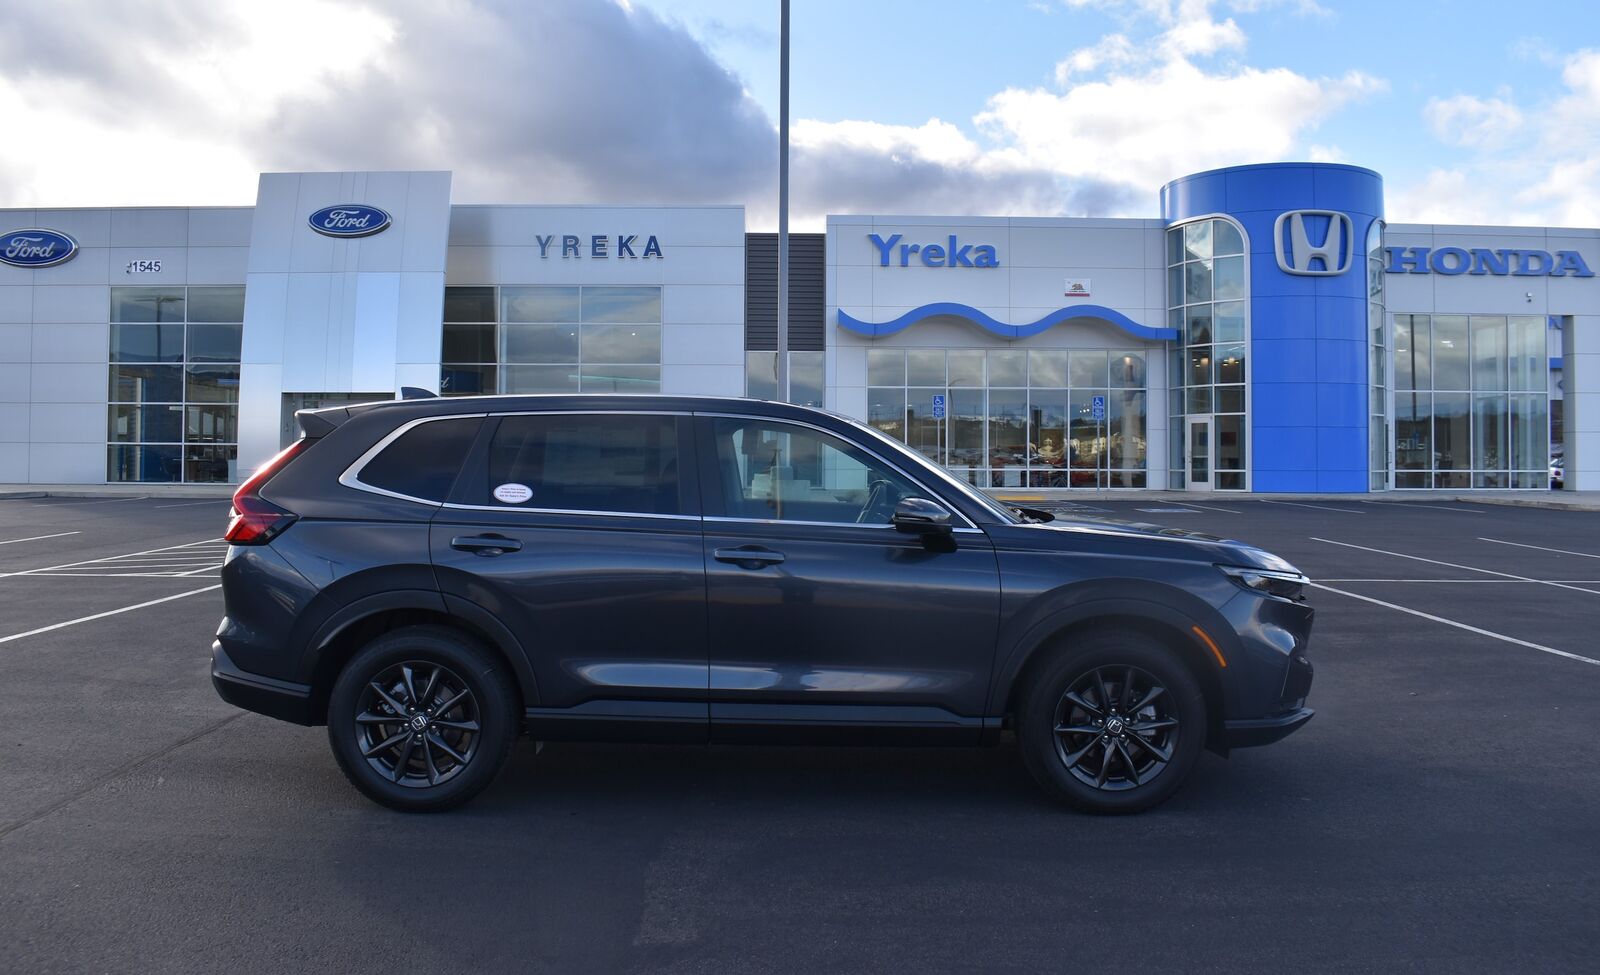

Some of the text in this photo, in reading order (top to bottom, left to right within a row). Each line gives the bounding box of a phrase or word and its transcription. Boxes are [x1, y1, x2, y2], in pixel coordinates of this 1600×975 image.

[324, 210, 371, 228] Ford
[5, 237, 56, 258] Ford
[536, 235, 664, 259] YREKA
[868, 233, 1000, 268] Yreka
[132, 261, 161, 272] 1545
[1385, 247, 1595, 278] HONDA
